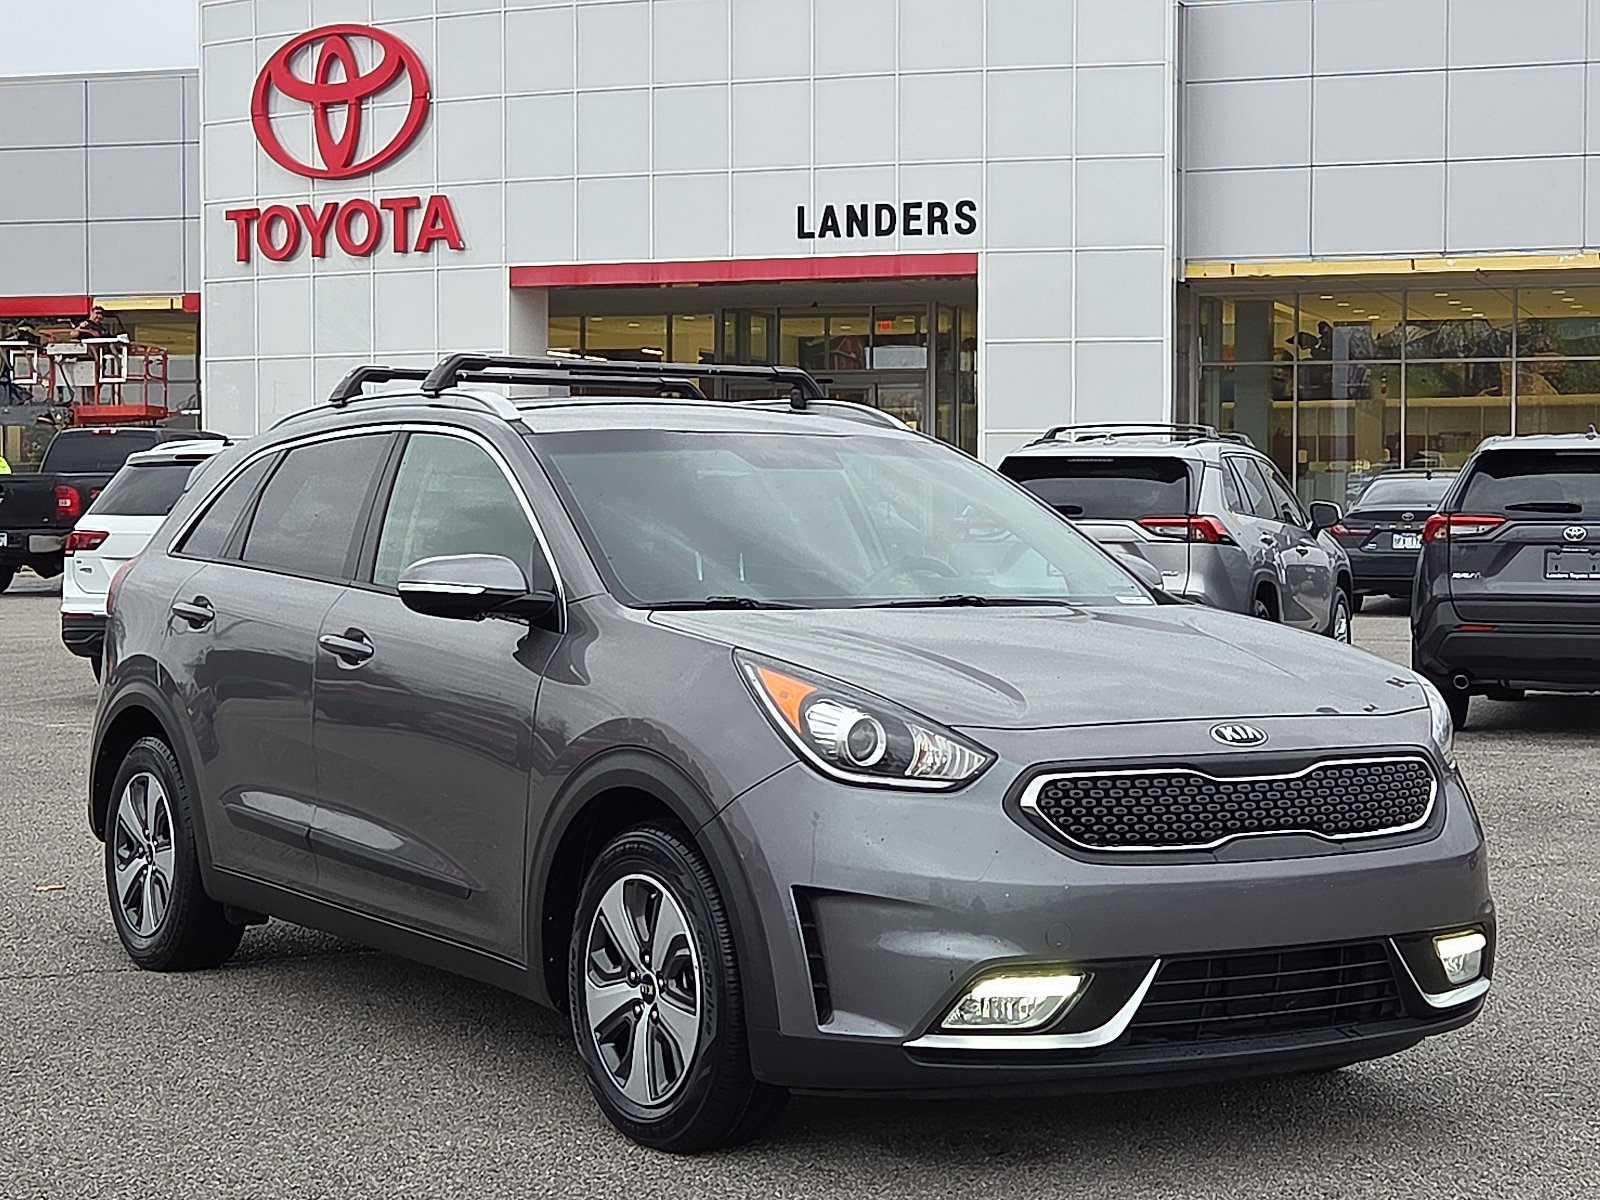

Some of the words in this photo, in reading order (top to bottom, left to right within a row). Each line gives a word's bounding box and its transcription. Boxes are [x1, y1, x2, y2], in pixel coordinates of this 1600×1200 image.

[226, 195, 465, 263] TOYOTA
[797, 200, 977, 239] LANDERS
[1218, 724, 1262, 741] KIA
